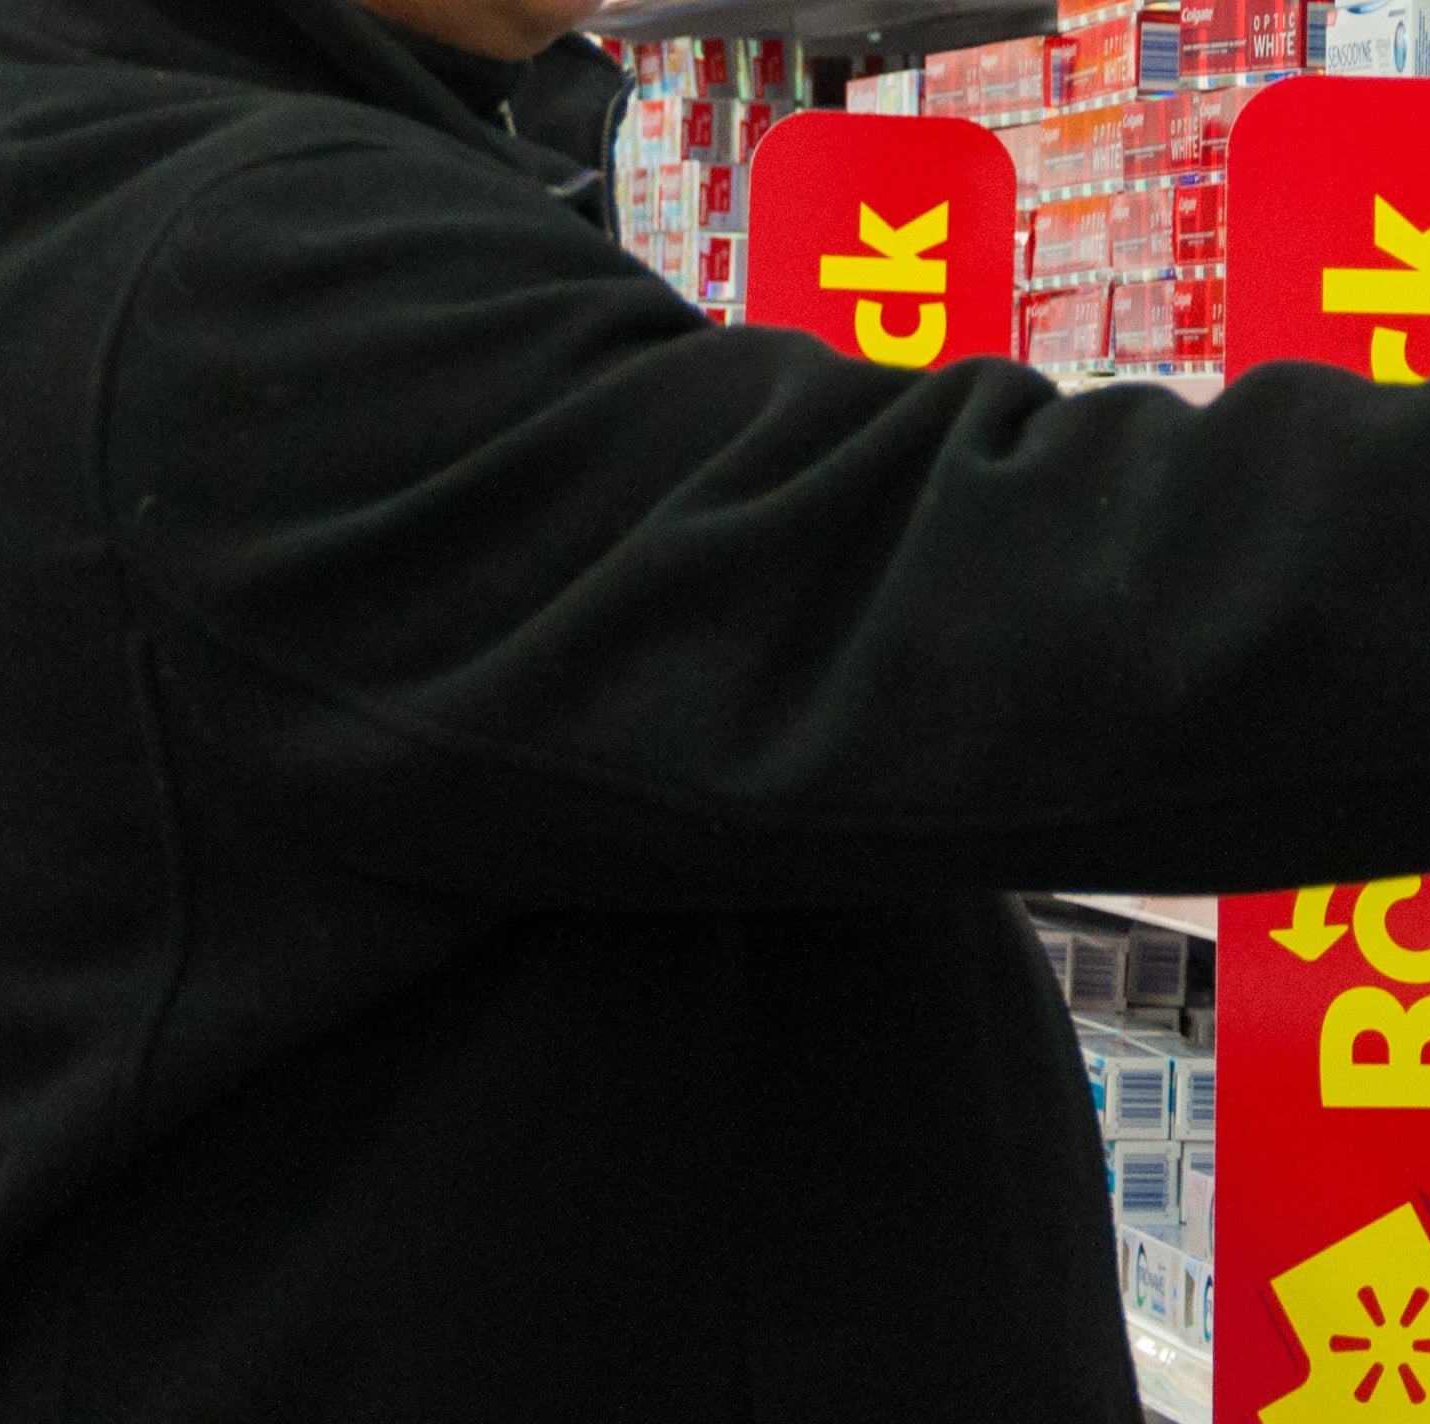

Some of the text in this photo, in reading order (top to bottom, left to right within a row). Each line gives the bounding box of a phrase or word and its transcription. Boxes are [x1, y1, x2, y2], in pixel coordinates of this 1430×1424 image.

[1180, 6, 1215, 26] Colgate
[1253, 14, 1297, 32] OPTIC
[1253, 29, 1297, 59] WHITE
[1327, 41, 1372, 69] SENSODYNE
[1171, 134, 1200, 160] WHITE
